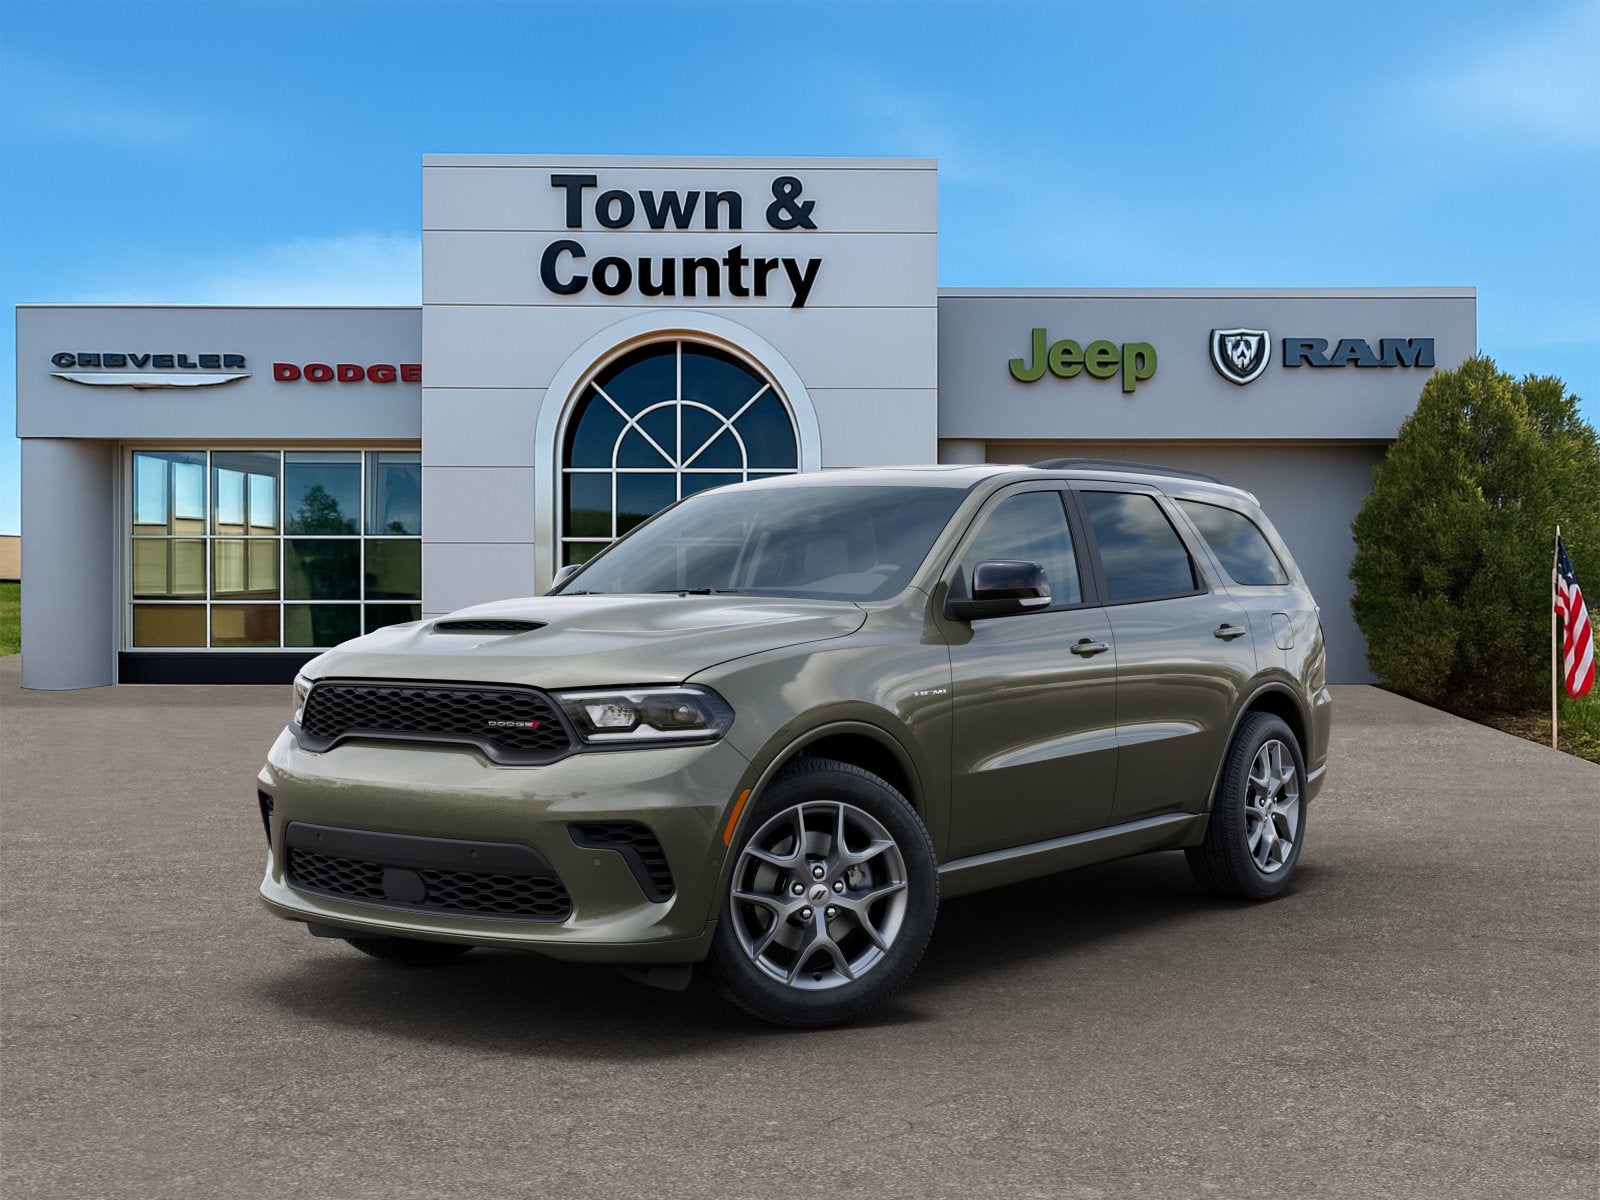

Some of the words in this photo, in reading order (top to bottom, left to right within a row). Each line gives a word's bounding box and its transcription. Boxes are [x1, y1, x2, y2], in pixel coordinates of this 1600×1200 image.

[551, 174, 743, 230] Town
[765, 175, 818, 230] &
[539, 239, 822, 308] Country
[273, 362, 421, 382] DODGE
[1009, 327, 1158, 393] Jeep
[1282, 337, 1436, 368] RAM
